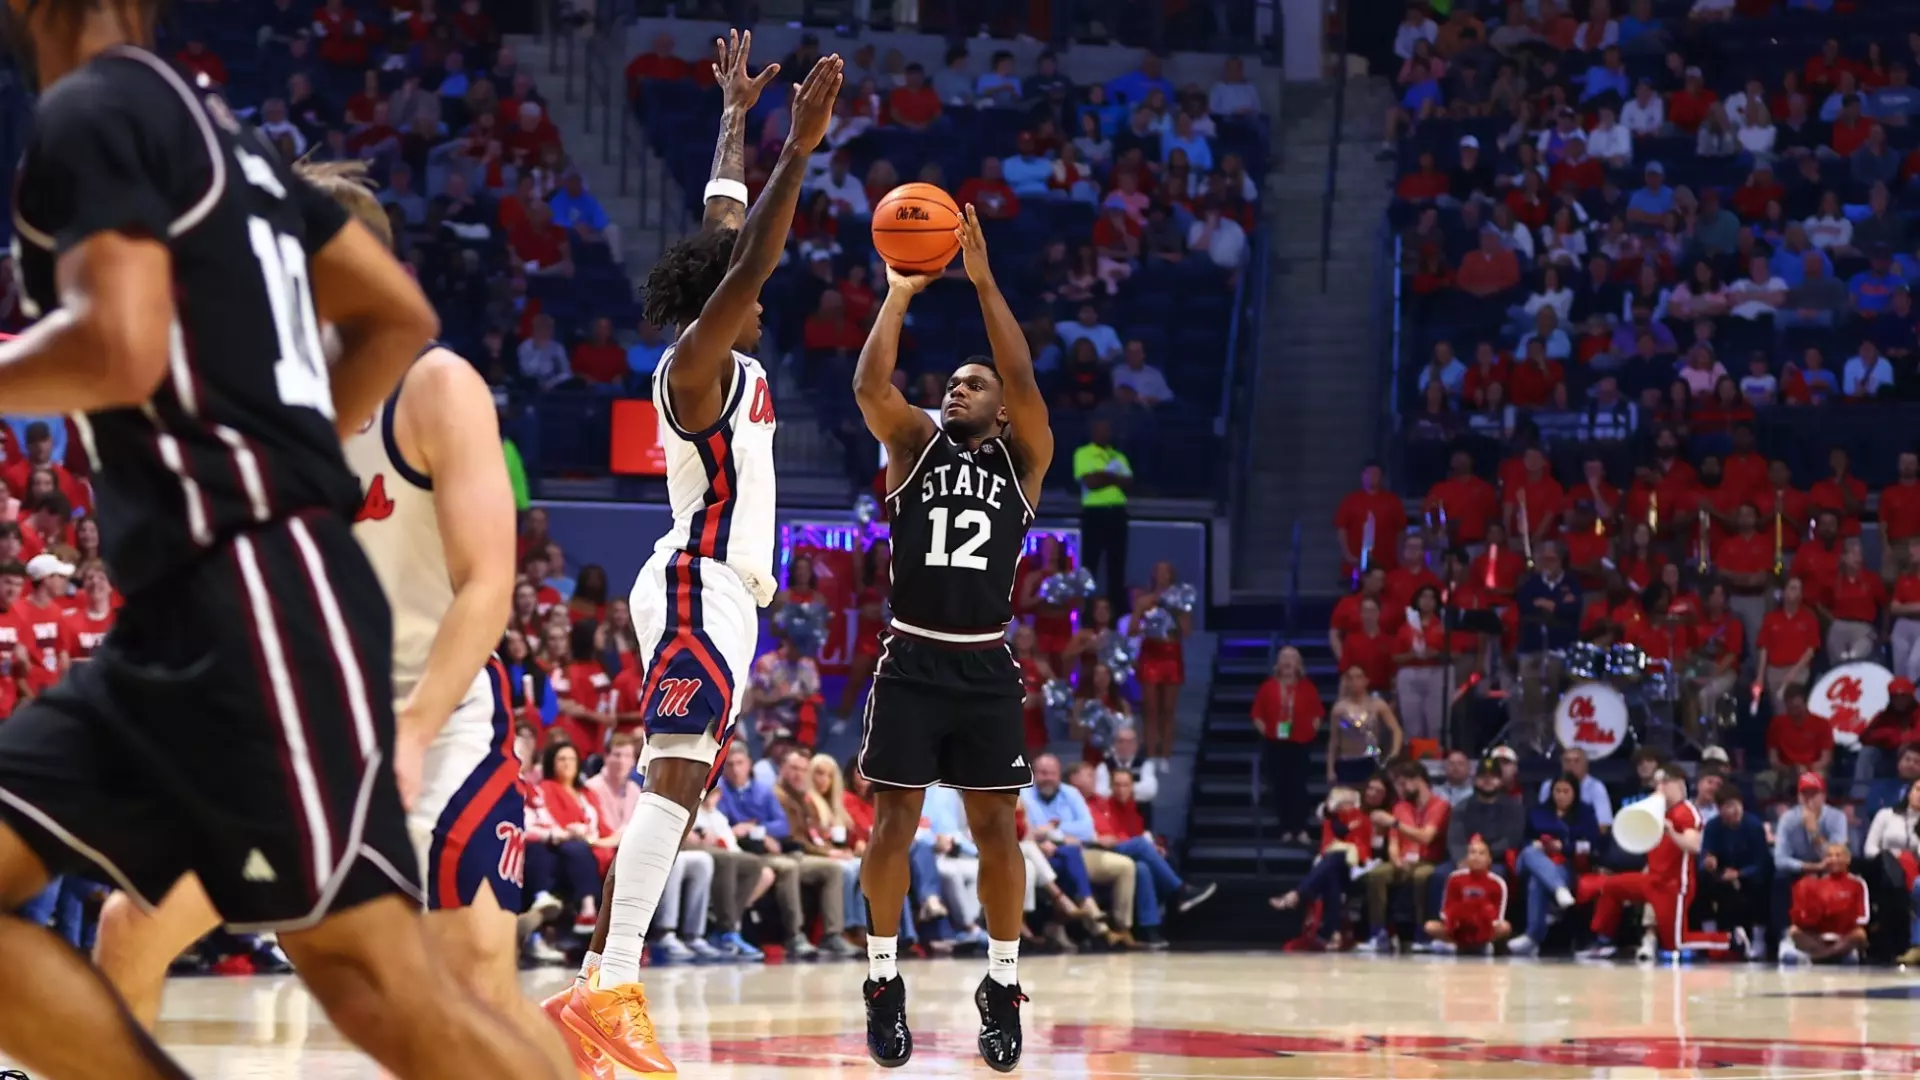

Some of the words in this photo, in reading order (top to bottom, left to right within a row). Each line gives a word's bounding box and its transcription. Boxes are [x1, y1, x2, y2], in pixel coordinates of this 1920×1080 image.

[896, 206, 908, 220] Ole
[909, 206, 929, 220] Miss
[921, 463, 1007, 510] STATE
[924, 506, 992, 571] 12
[656, 677, 703, 717] M
[1827, 674, 1863, 703] Ole
[1567, 694, 1597, 718] Ole
[1574, 720, 1616, 745] Miss
